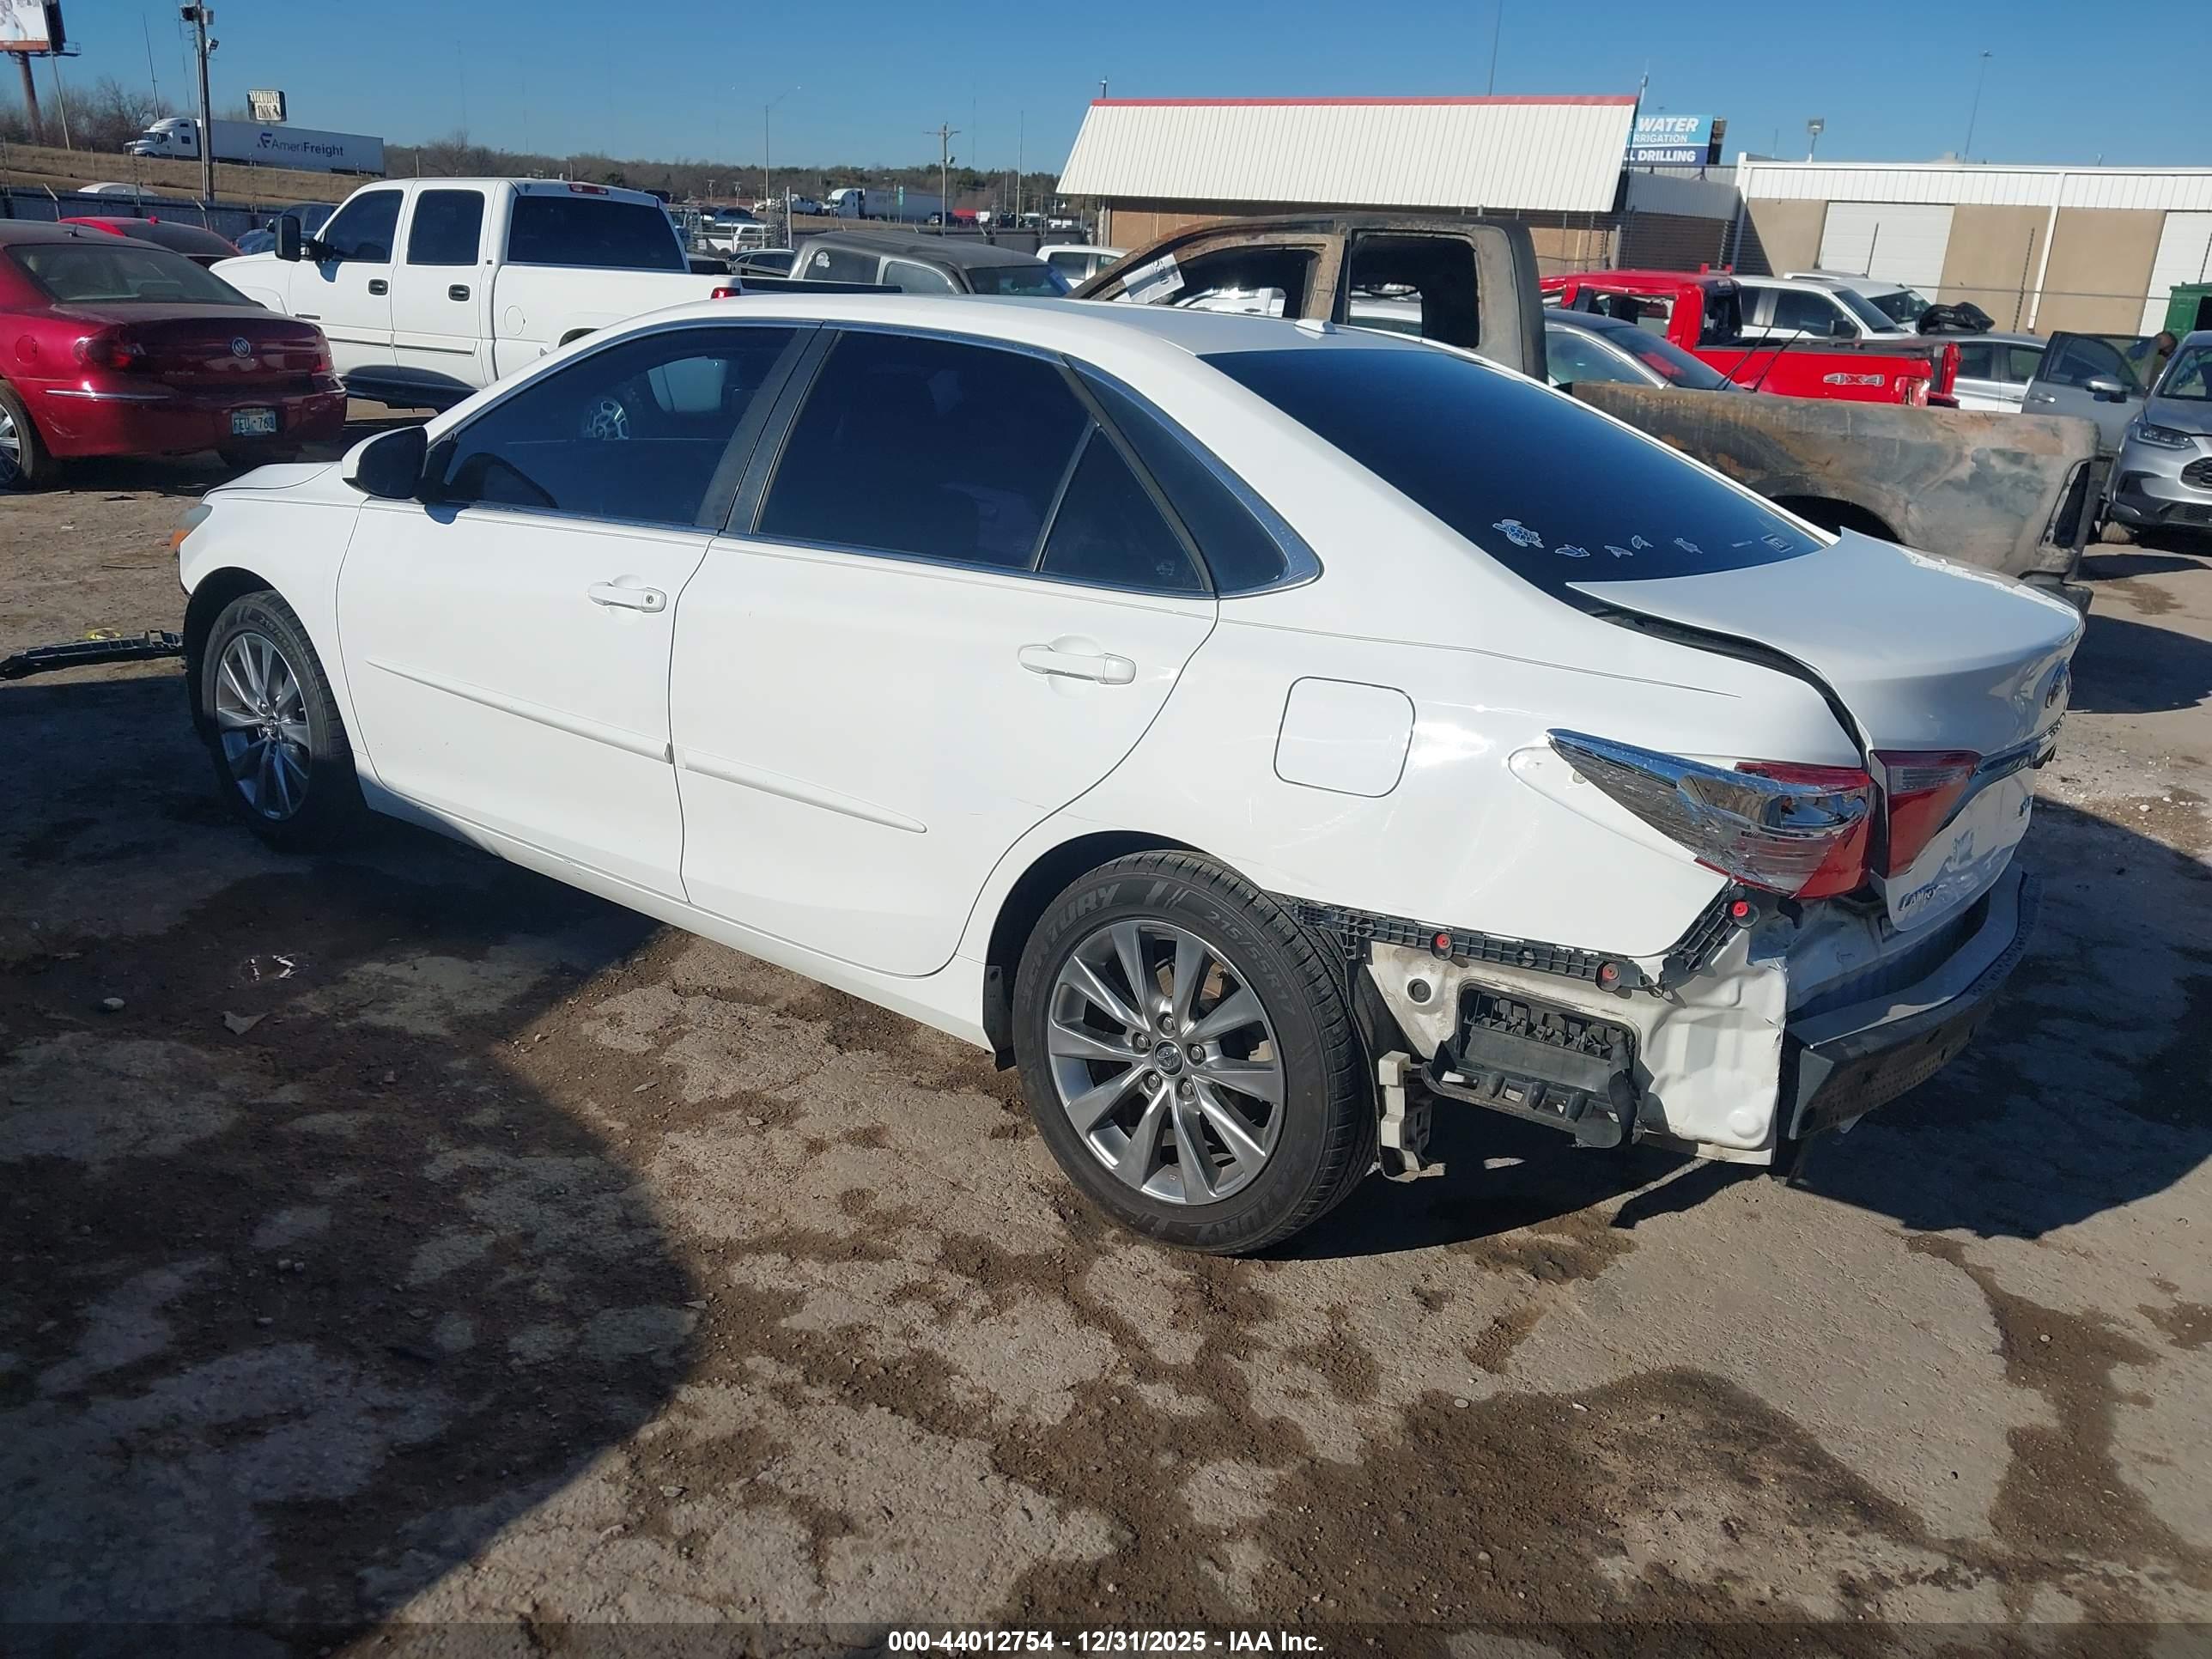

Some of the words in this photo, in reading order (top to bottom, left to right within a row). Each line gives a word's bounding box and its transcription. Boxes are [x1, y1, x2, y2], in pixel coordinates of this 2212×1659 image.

[258, 105, 272, 118] INN
[1638, 117, 1698, 132] WATER
[1632, 133, 1688, 143] RRIGATION
[271, 137, 343, 158] AmeriFreight
[1638, 149, 1697, 162] DRILLING
